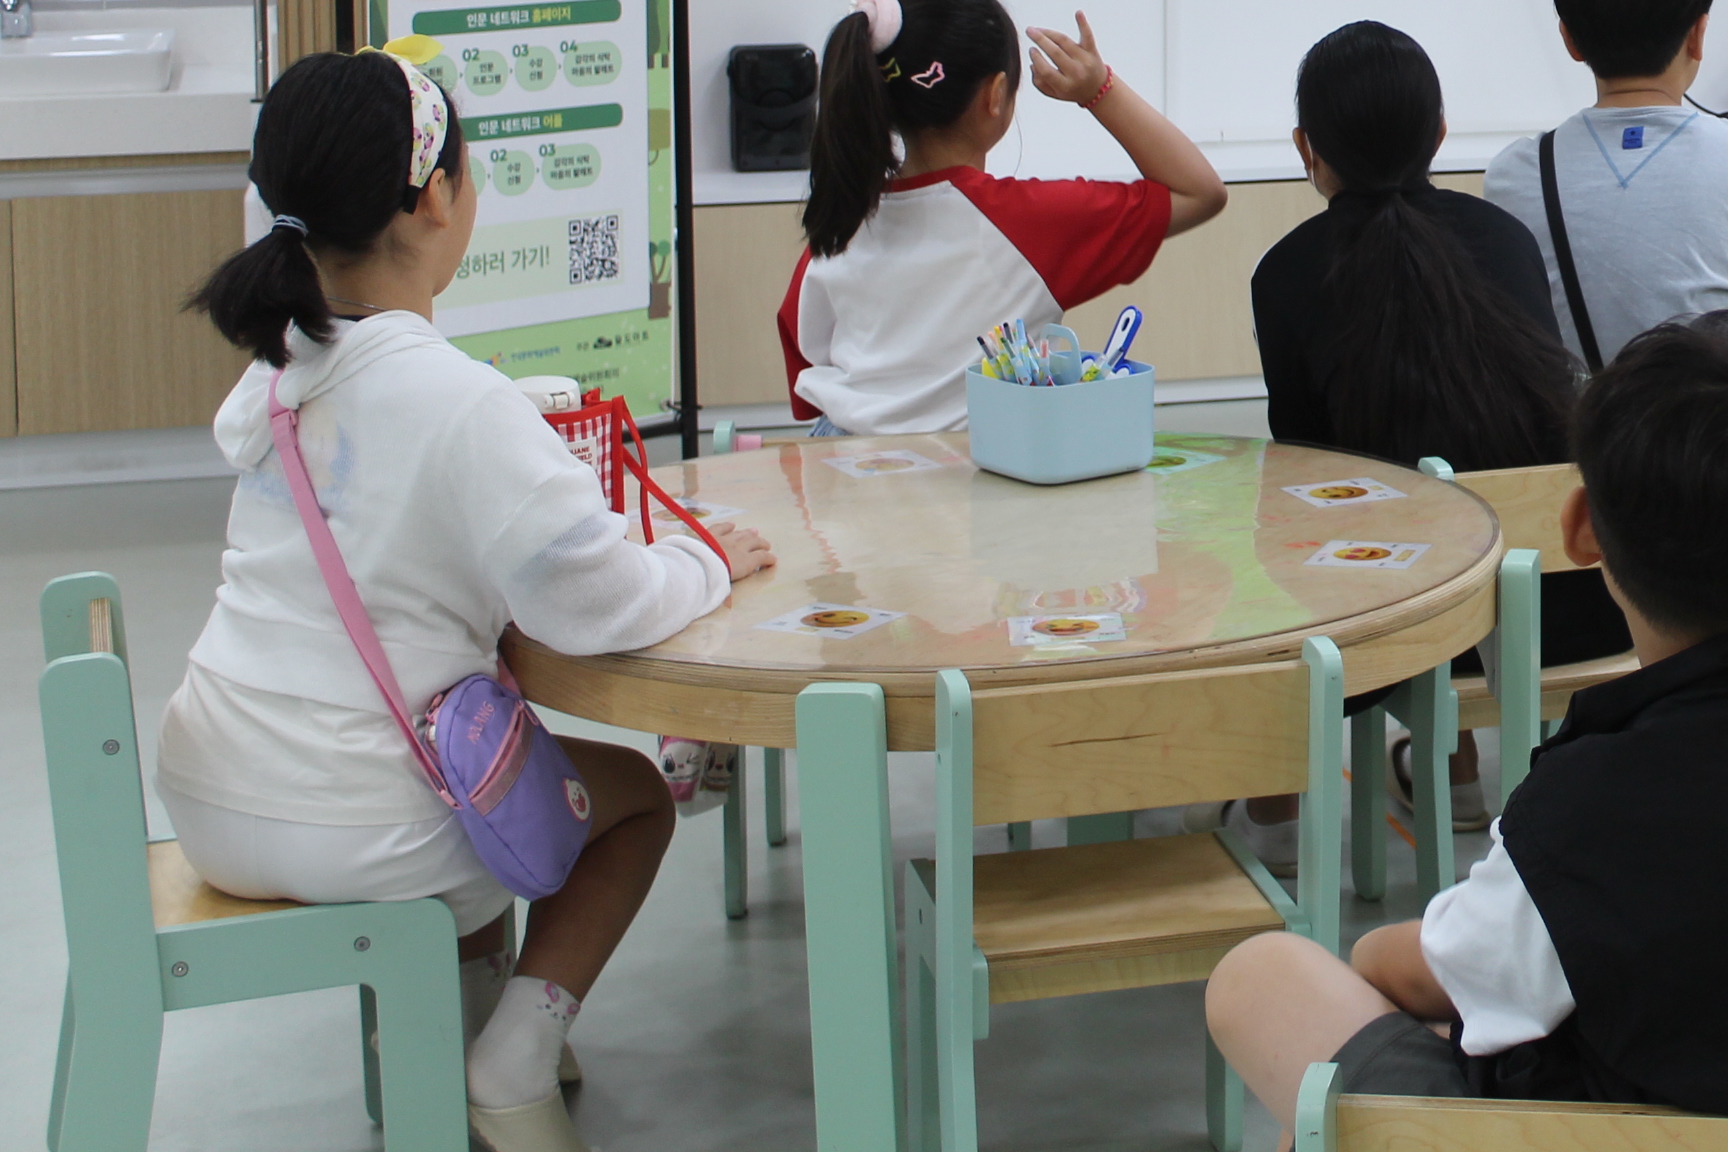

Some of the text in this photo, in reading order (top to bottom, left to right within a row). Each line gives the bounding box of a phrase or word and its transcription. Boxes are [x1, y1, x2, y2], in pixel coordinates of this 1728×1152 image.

[466, 5, 571, 29] 인문 네트워크 홈페이지
[512, 44, 529, 58] 03
[560, 39, 578, 54] 04
[462, 48, 480, 62] 02
[478, 119, 499, 137] 인문
[501, 116, 541, 134] 네트워크
[490, 149, 507, 163] 02
[538, 144, 556, 157] 03
[511, 244, 550, 271] 가기!
